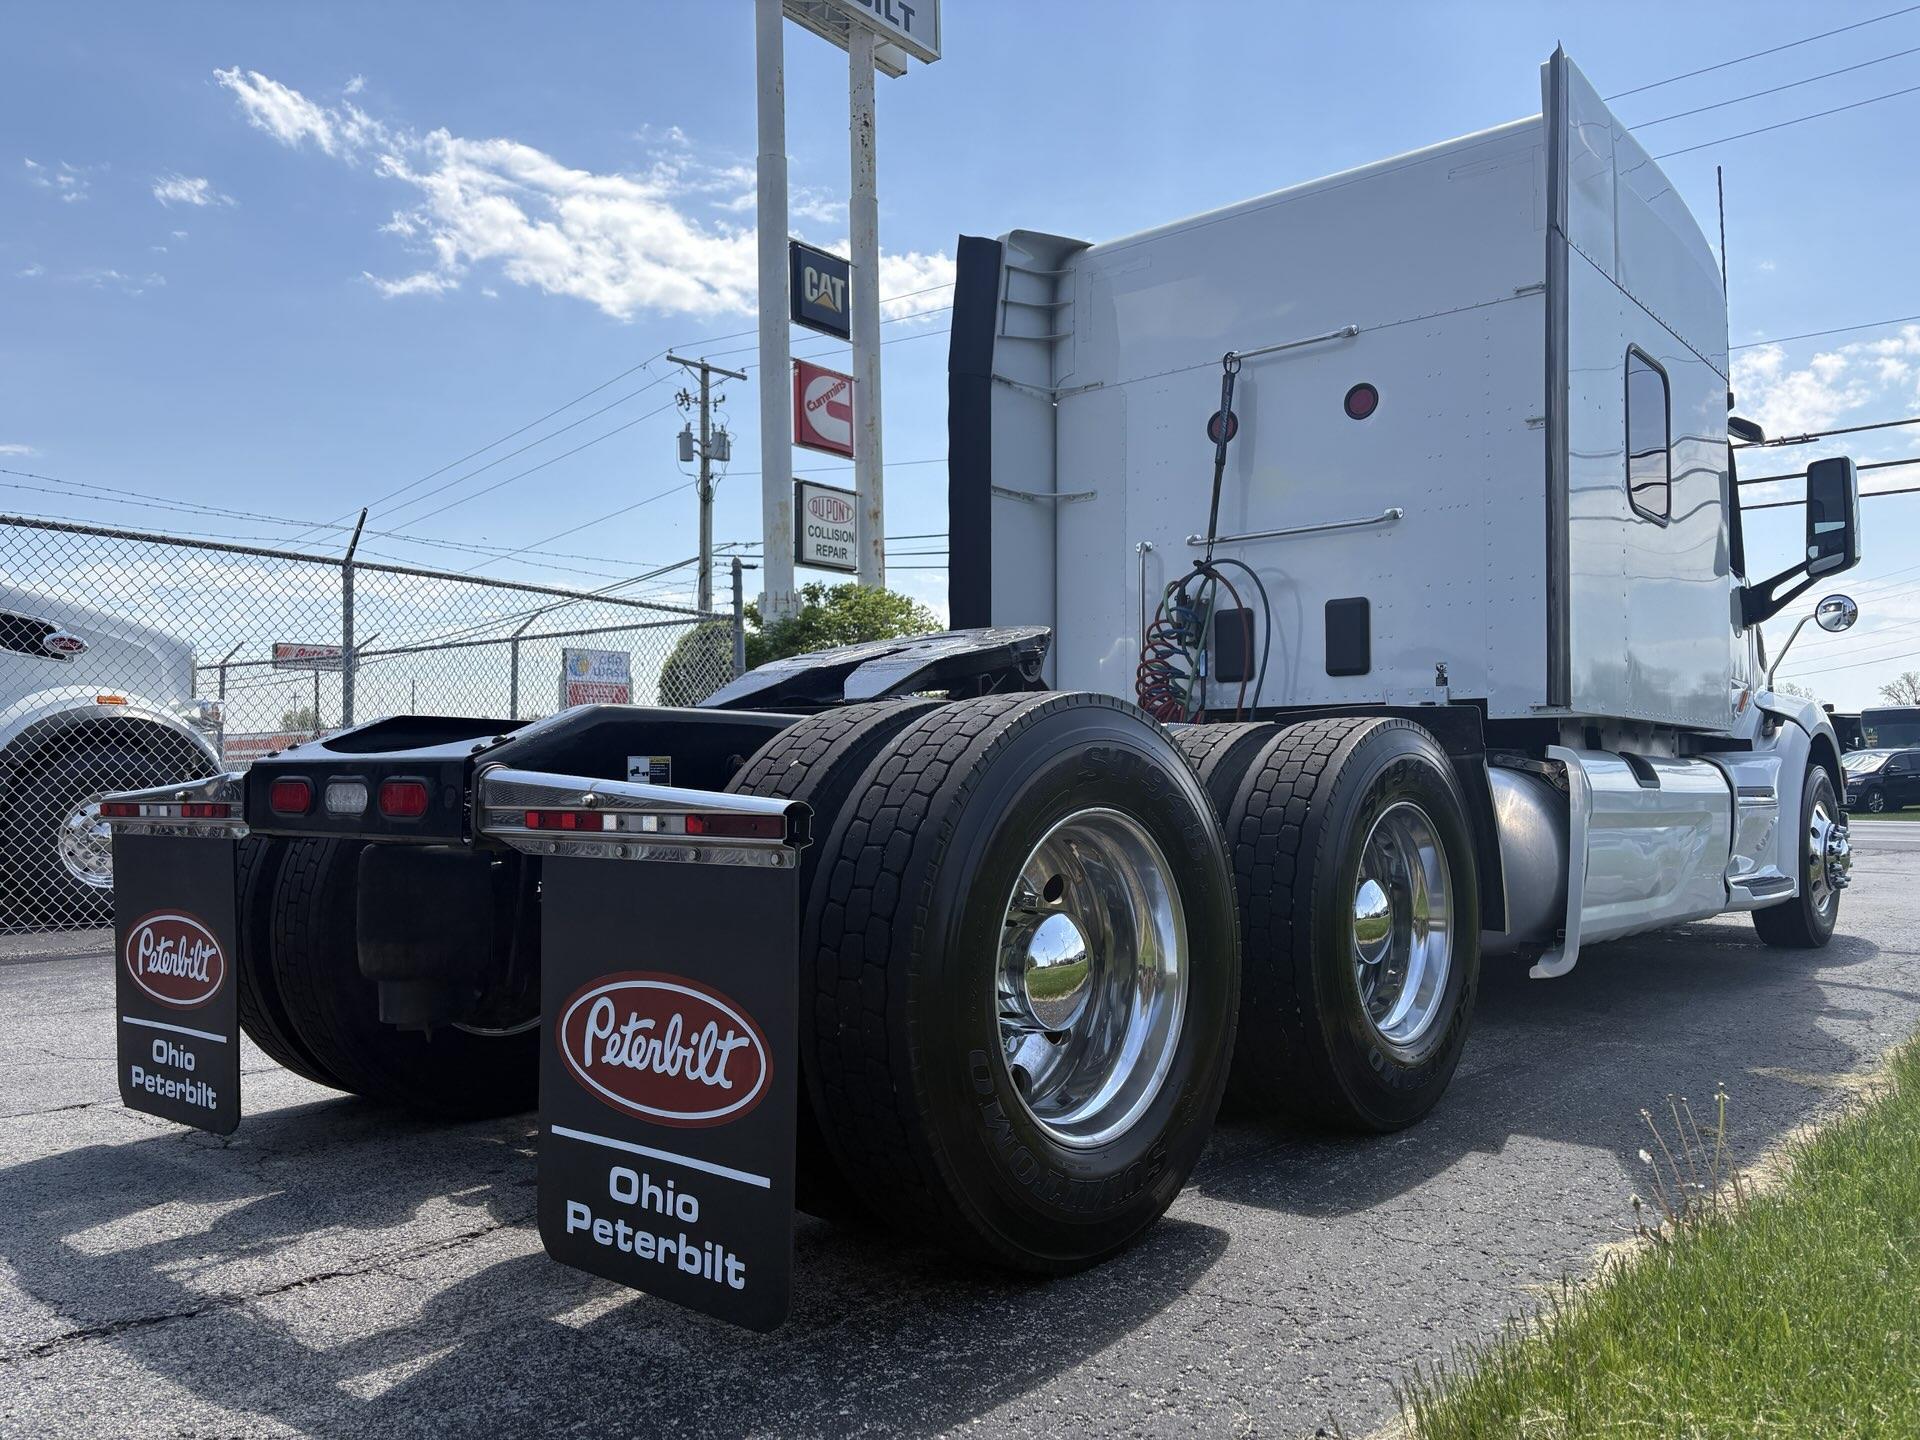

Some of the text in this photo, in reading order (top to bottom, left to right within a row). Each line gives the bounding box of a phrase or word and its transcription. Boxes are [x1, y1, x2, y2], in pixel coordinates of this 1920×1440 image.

[857, 0, 916, 33] ILT
[804, 266, 845, 313] CAT
[807, 381, 847, 412] Cummins
[808, 525, 855, 544] COLLISION
[816, 544, 848, 560] REPAIR
[593, 666, 629, 678] WASH
[599, 654, 623, 666] CAR
[138, 927, 217, 983] Peterbilt
[152, 1038, 196, 1072] Ohio
[584, 996, 750, 1090] Peterbilt
[131, 1064, 217, 1110] Peterbilt
[609, 1166, 700, 1224] Ohio
[566, 1199, 746, 1291] Peterbilt
